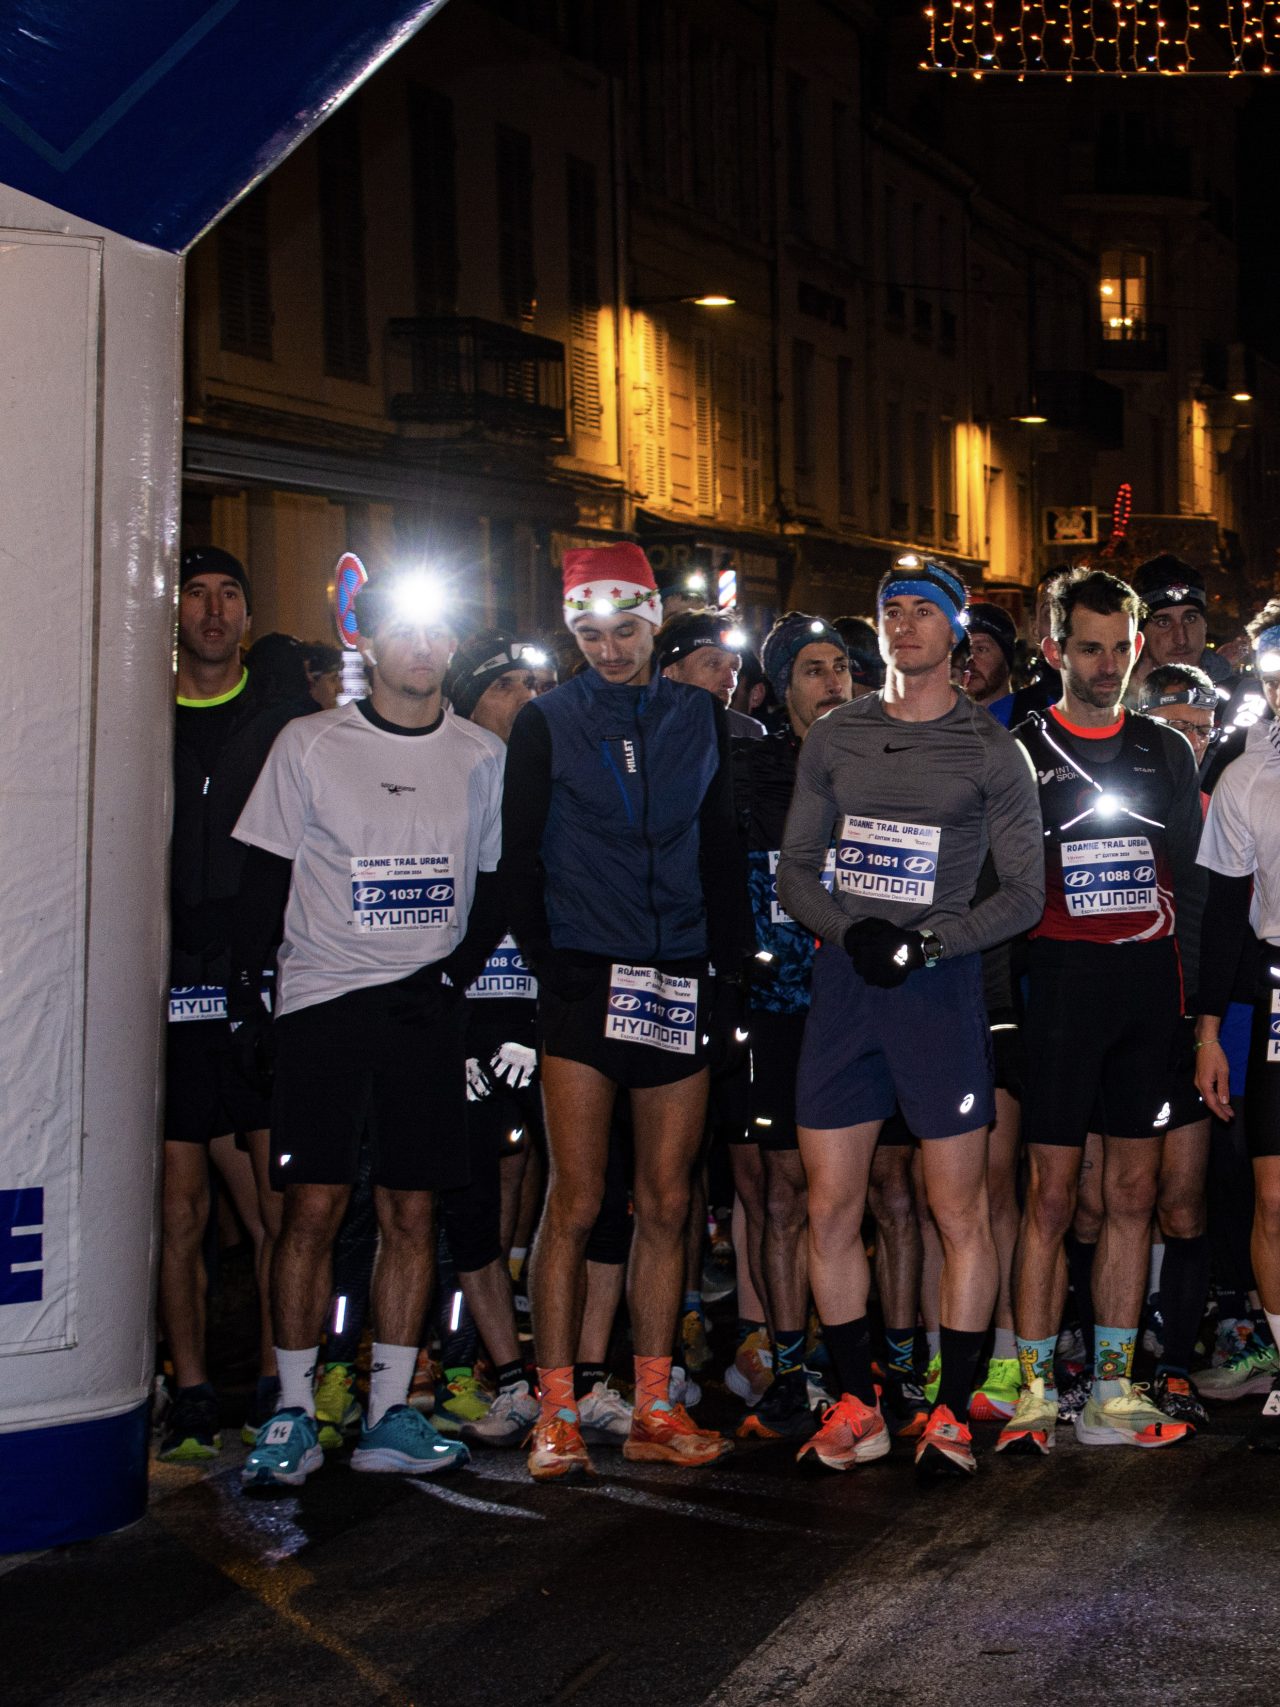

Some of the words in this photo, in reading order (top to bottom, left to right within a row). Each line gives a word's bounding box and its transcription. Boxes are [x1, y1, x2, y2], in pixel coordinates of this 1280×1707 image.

[624, 740, 637, 773] MILLET
[849, 819, 875, 830] ROANNE
[876, 822, 899, 834] TRAIL
[902, 826, 934, 837] URBAIN
[1066, 842, 1099, 853] ROANNE
[1102, 840, 1125, 849] TRAIL
[357, 859, 391, 868] ROANNE
[394, 858, 418, 867] TRAIL
[420, 857, 449, 865] URBAIN
[867, 854, 899, 867] 1051
[1099, 870, 1130, 882] 1088
[841, 871, 925, 896] HYUNDAI
[390, 889, 422, 900] 1037
[1071, 890, 1151, 910] HYUNDAI
[361, 908, 448, 926] HYUNDAI
[618, 967, 652, 978] ROANNE
[470, 977, 531, 991] UNDAI
[612, 1017, 687, 1045] HYUNDAI
